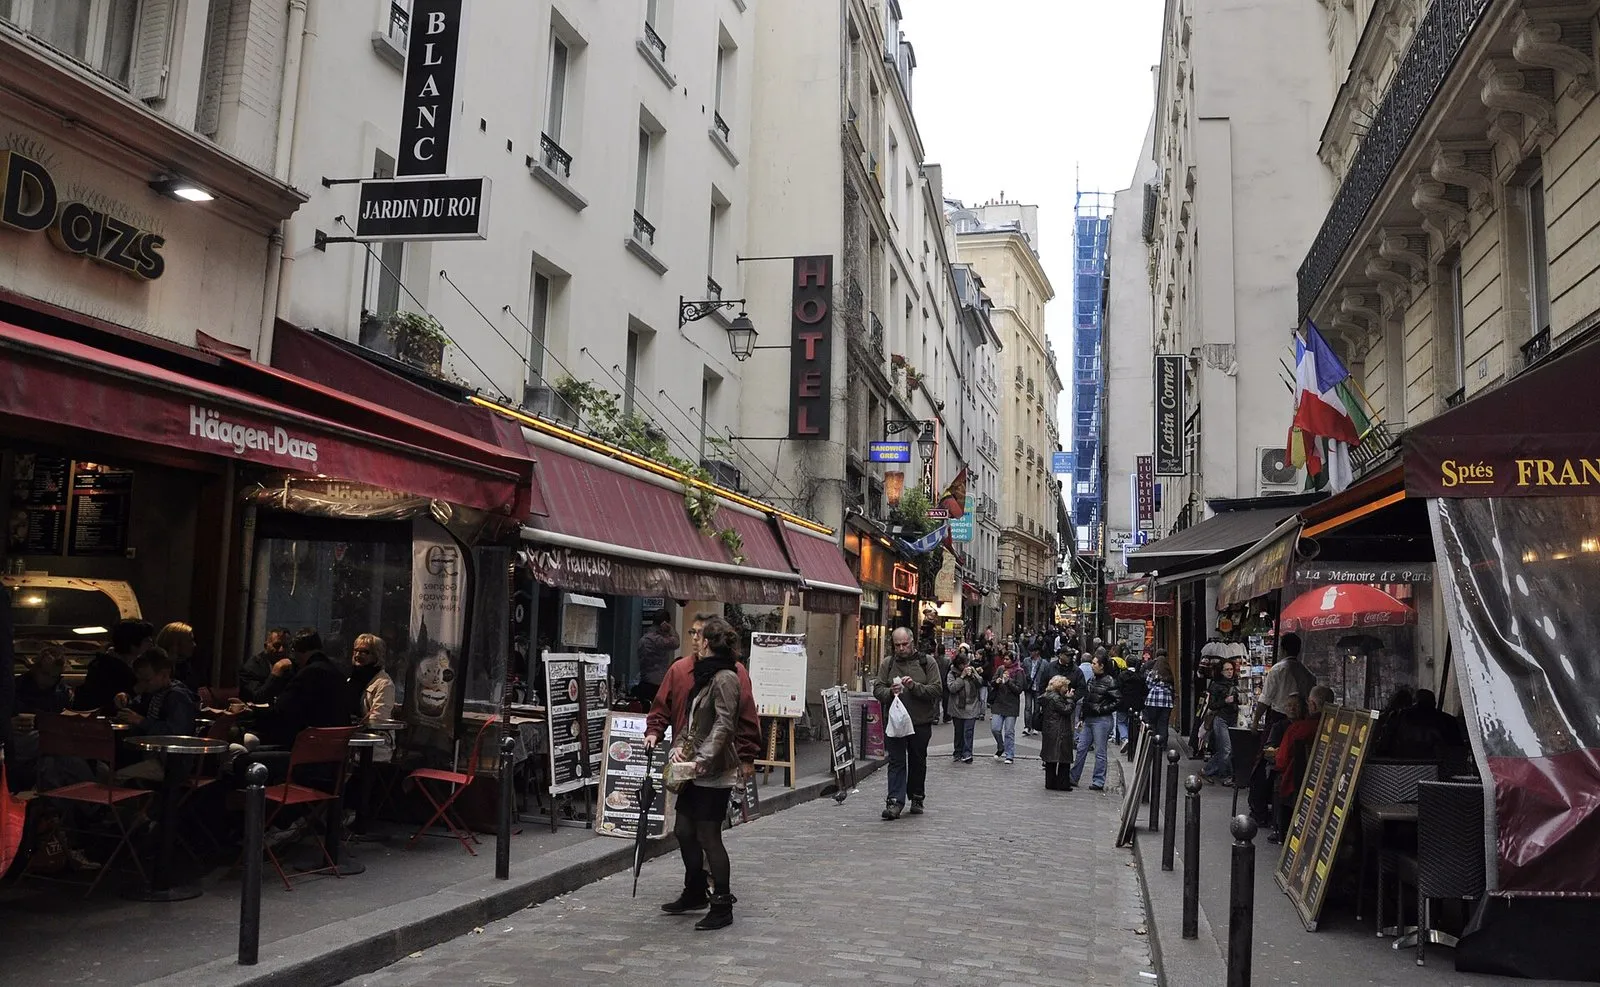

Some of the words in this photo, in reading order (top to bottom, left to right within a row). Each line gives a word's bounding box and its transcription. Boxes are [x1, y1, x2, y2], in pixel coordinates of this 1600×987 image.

[413, 11, 446, 161] BLANC
[1, 150, 166, 281] Dazs
[362, 199, 420, 220] JARDIN
[421, 198, 445, 218] DU
[447, 196, 477, 217] ROI
[794, 257, 829, 435] HOTEL
[1160, 357, 1176, 409] Corner
[189, 404, 318, 462] Häagen-Dazs
[1160, 411, 1175, 457] Latin
[1138, 457, 1146, 504] BISTRO
[1440, 460, 1495, 487] Sptés
[1515, 458, 1600, 486] FRAN
[564, 548, 612, 577] Française
[1305, 570, 1321, 580] La
[1327, 570, 1376, 582] Mémoire
[1380, 570, 1396, 582] de
[1402, 570, 1432, 582] Paris
[1311, 613, 1341, 627] Coca-Cola
[1363, 611, 1393, 624] Coca-Cola
